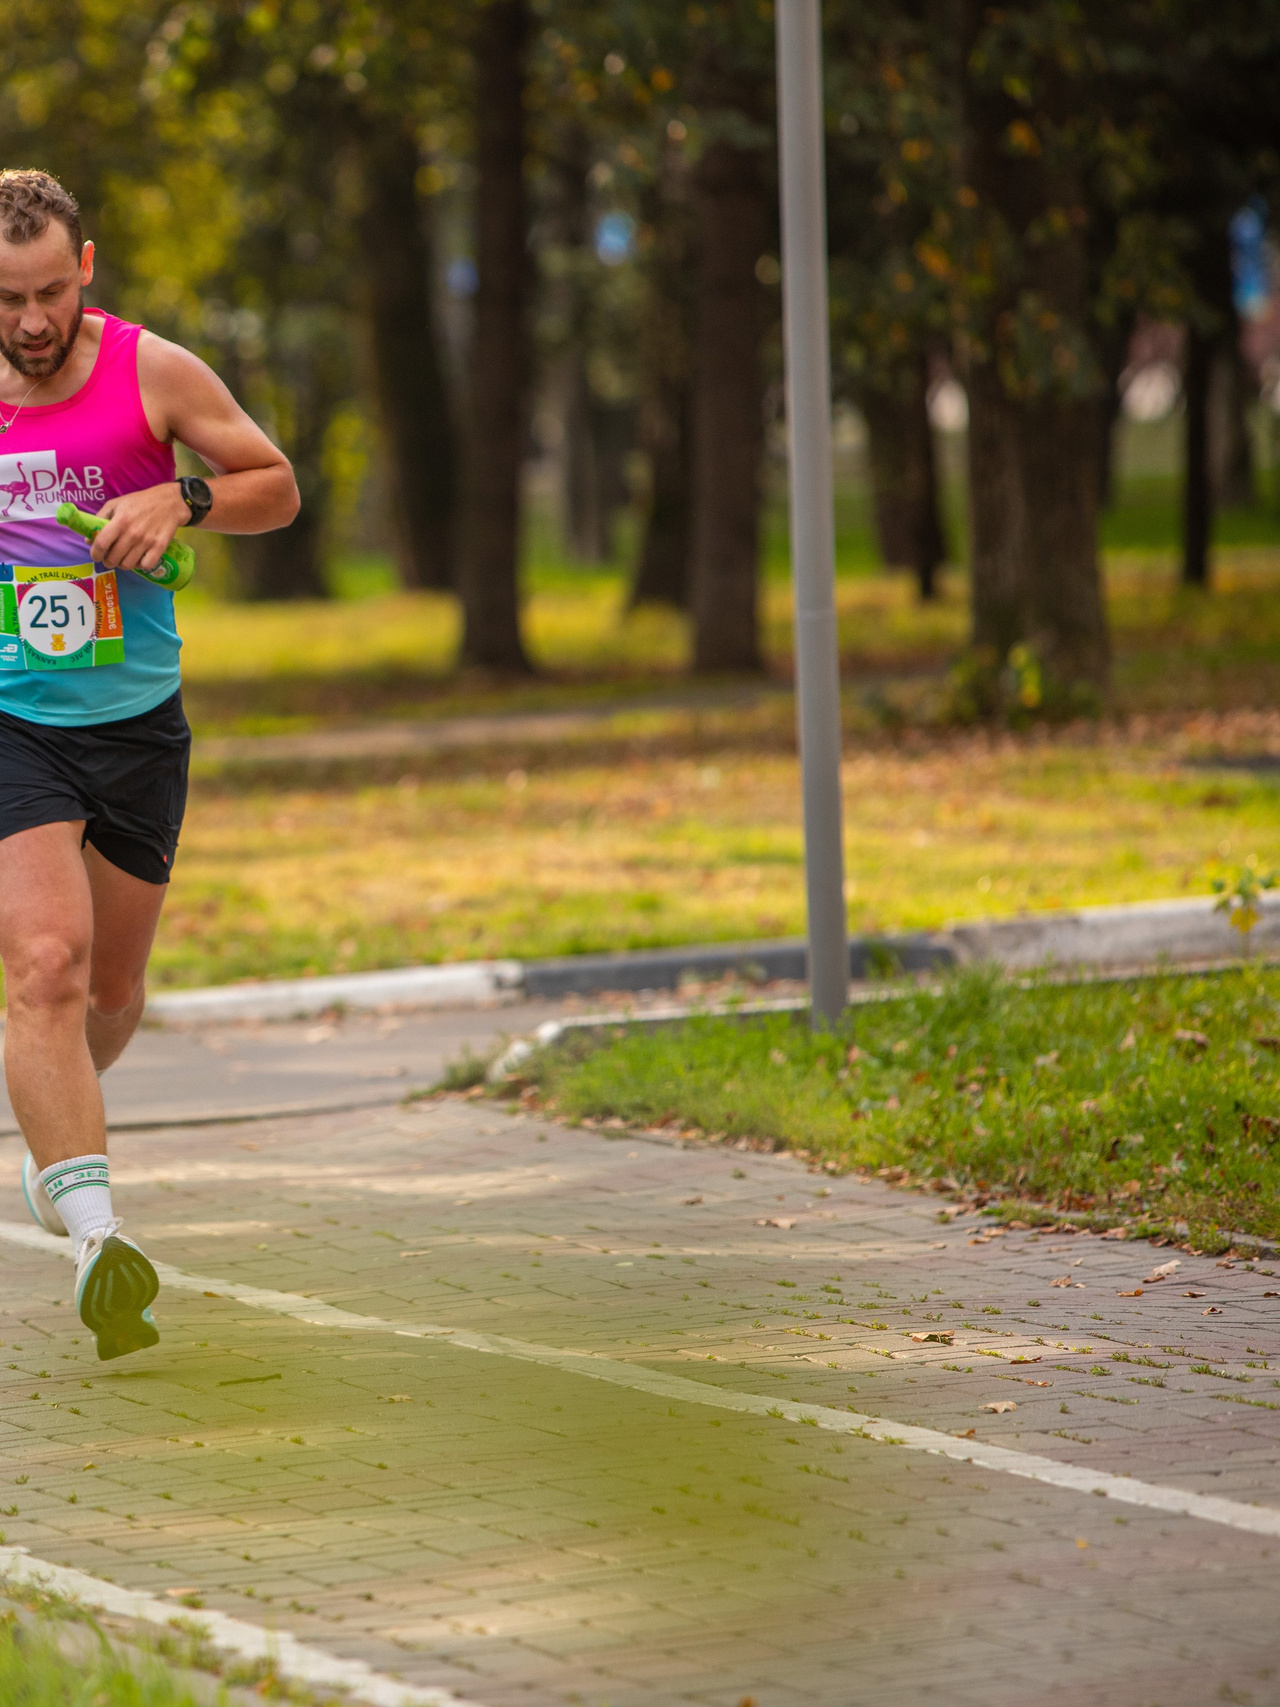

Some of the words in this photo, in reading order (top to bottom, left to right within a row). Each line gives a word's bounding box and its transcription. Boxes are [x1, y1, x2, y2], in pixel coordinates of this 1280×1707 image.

[31, 466, 105, 492] DAB
[35, 488, 105, 505] RUNNING
[17, 575, 39, 596] DREAM
[38, 571, 60, 580] TRAIL
[61, 572, 91, 591] LYSKOVO
[28, 594, 70, 629] 25
[77, 605, 86, 627] 1
[105, 583, 117, 631] ЭСТАФЕТА
[69, 651, 84, 663] ЛЕС
